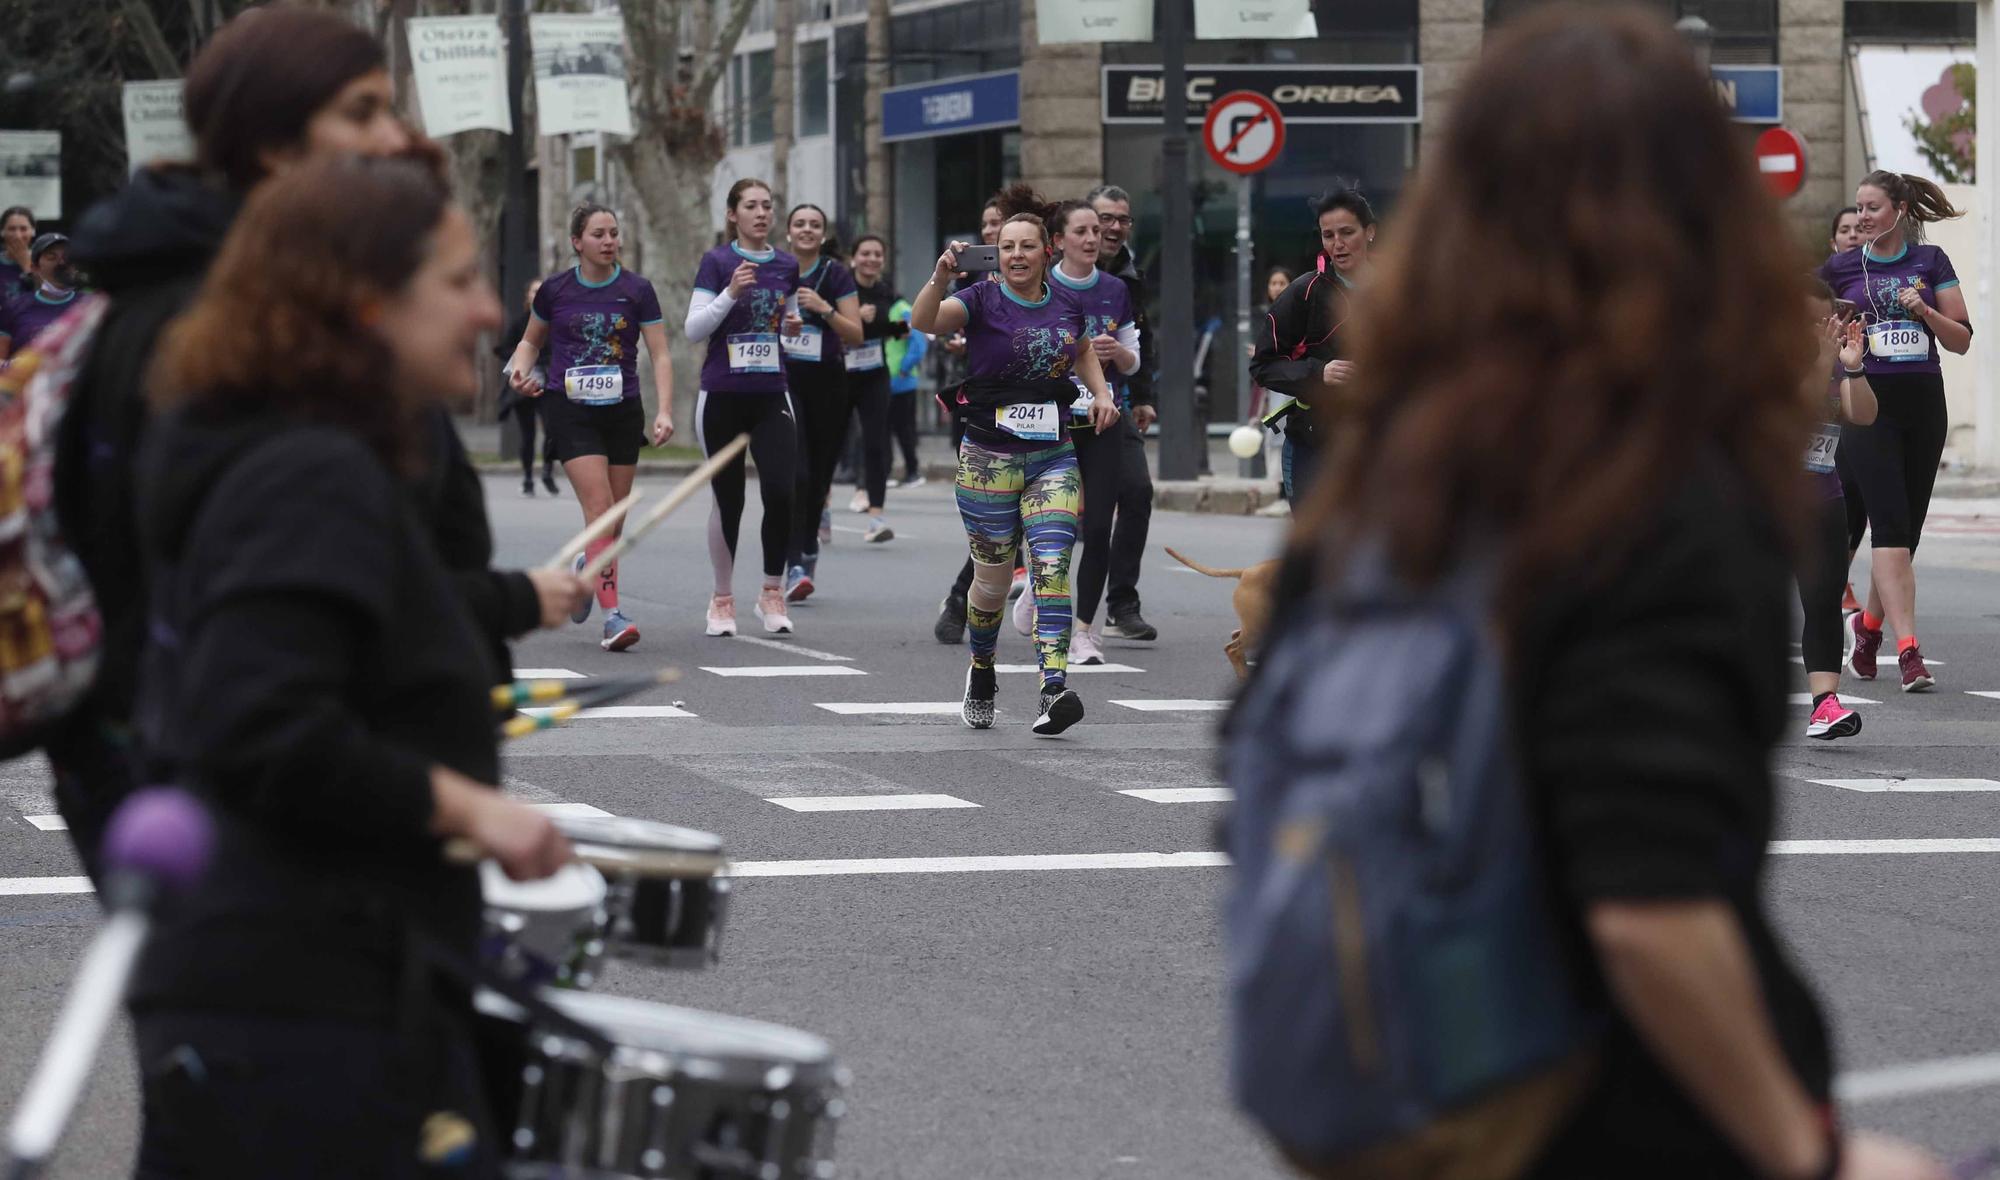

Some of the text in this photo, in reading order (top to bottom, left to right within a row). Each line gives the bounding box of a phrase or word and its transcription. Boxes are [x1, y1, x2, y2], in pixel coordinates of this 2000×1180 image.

[418, 43, 499, 64] Chillida
[1127, 76, 1401, 103] BC ORBEA
[1881, 331, 1919, 346] 1808
[738, 344, 771, 358] 1499
[577, 376, 614, 391] 1498
[1009, 406, 1044, 420] 2041
